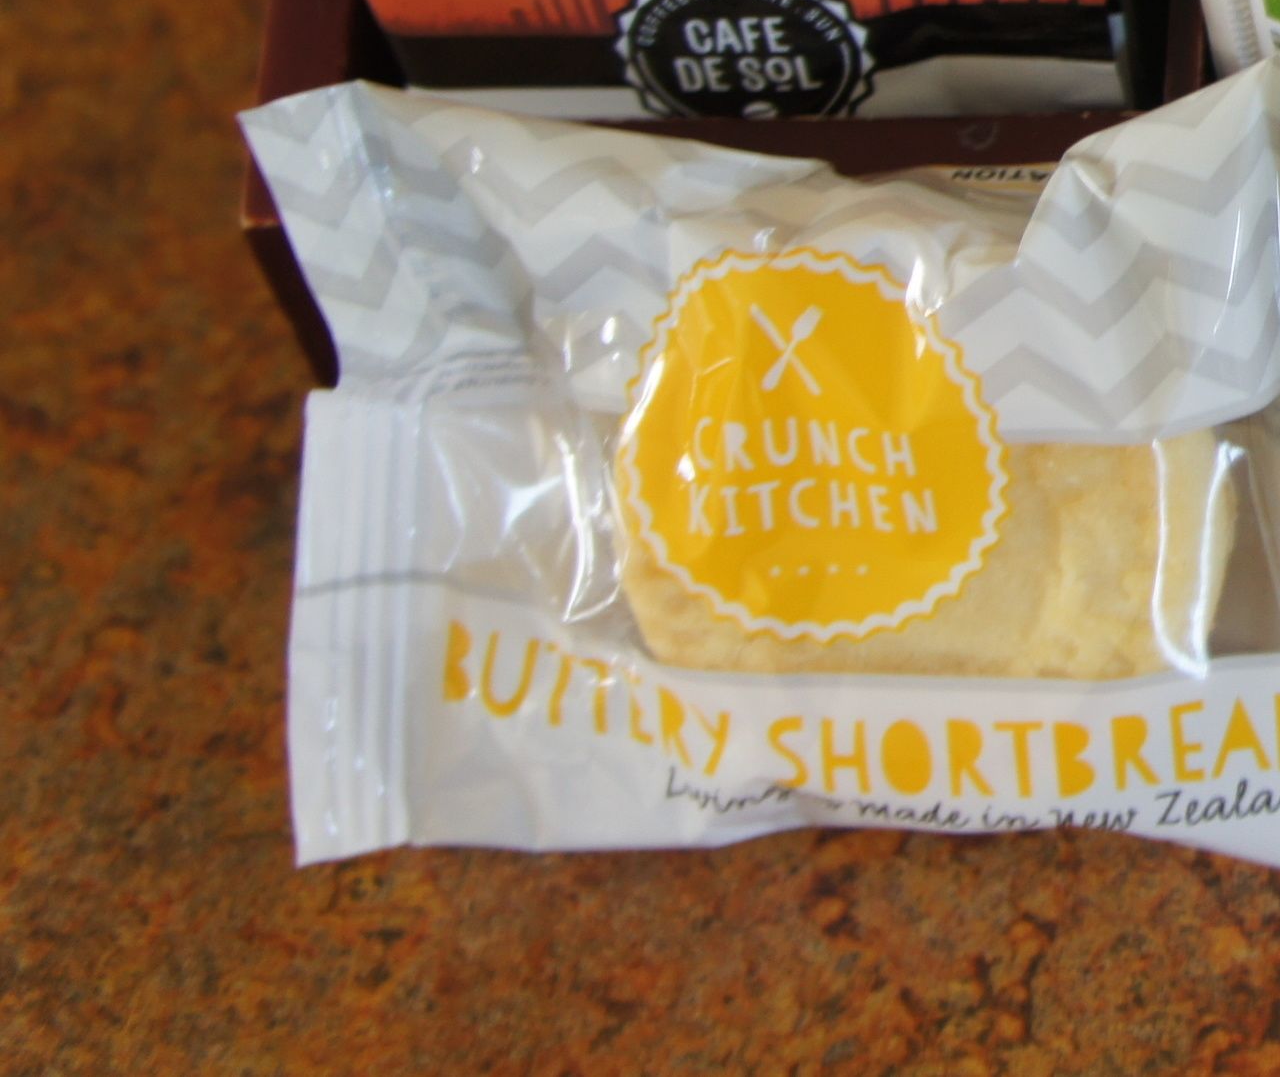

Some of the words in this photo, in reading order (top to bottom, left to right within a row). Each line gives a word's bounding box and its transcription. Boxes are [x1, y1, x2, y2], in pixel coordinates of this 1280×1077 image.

[684, 17, 790, 54] CAFE
[674, 56, 730, 93] DE
[694, 417, 917, 477] CRUNCH
[687, 477, 940, 536] KITCHEN
